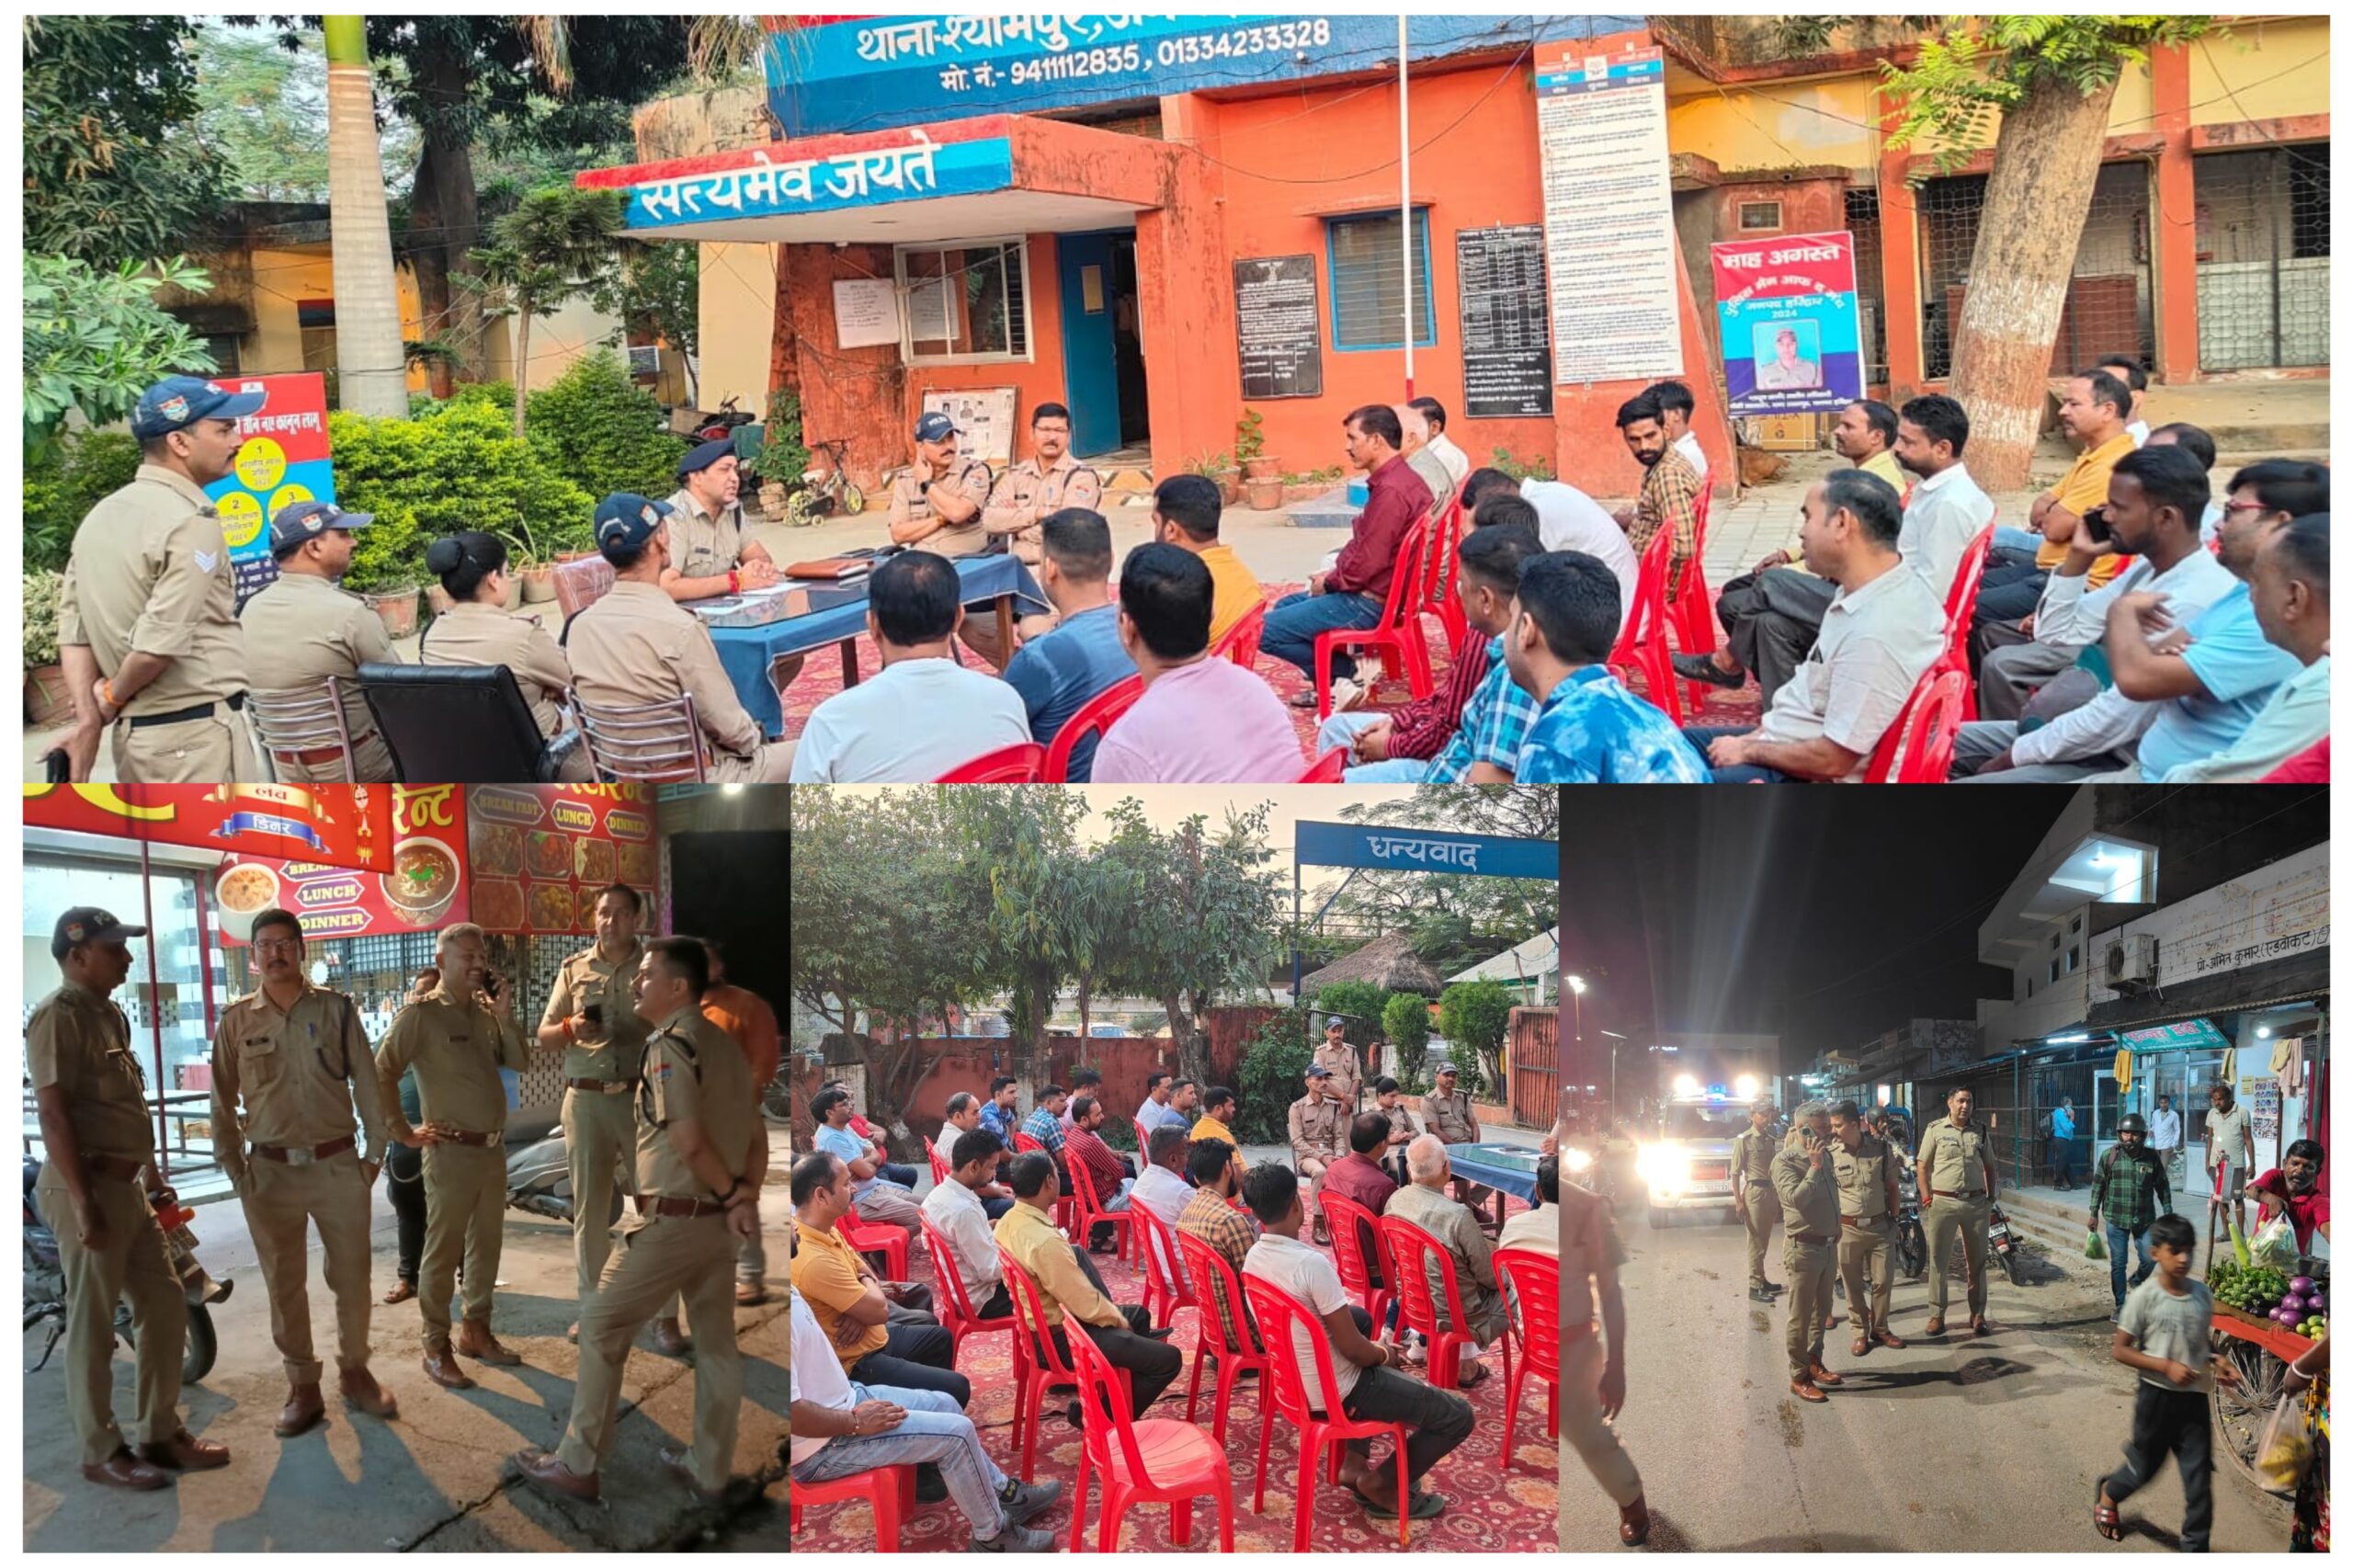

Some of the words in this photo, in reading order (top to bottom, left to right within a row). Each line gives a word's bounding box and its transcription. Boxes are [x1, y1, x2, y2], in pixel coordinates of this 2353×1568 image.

[1157, 18, 1331, 66] 01334233328
[636, 151, 818, 220] सत्यमेव
[824, 129, 942, 199] जयते
[1722, 251, 1764, 268] माह
[1768, 245, 1840, 266] अगस्त
[232, 499, 240, 510] 2
[253, 814, 293, 835] डिनर
[556, 808, 592, 826] LUNCH
[1366, 835, 1482, 872] धन्यवाद
[301, 884, 357, 902] LUNCH
[299, 914, 364, 929] DINNER
